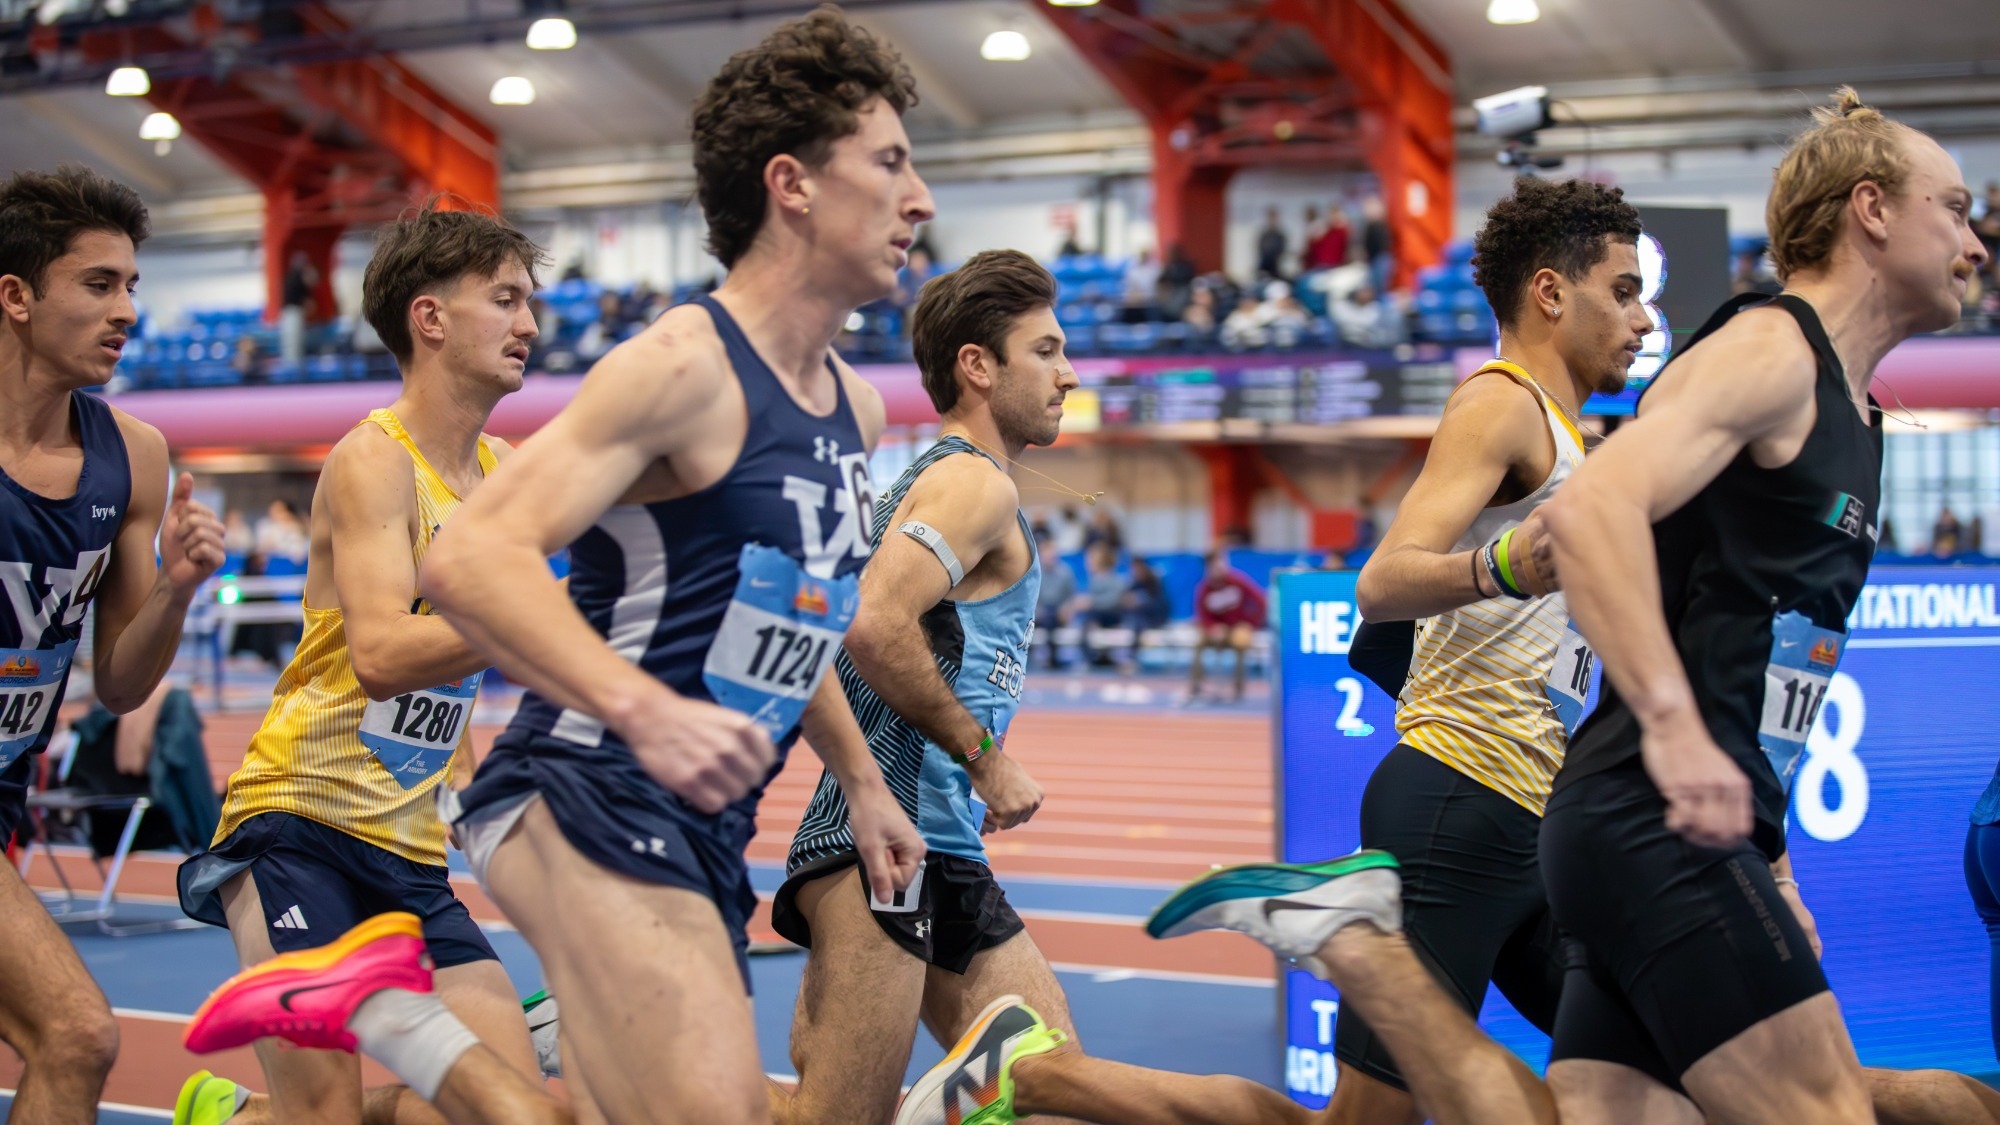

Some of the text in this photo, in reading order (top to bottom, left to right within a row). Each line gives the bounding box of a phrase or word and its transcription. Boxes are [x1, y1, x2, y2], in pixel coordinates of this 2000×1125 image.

[92, 505, 109, 520] Ivy
[851, 461, 874, 547] 6
[72, 551, 107, 615] 4
[746, 625, 829, 690] 1724
[986, 648, 1026, 703] HO
[1570, 645, 1595, 697] 16
[391, 693, 463, 744] 1280
[1334, 677, 1364, 731] 2
[1783, 672, 1869, 842] 8
